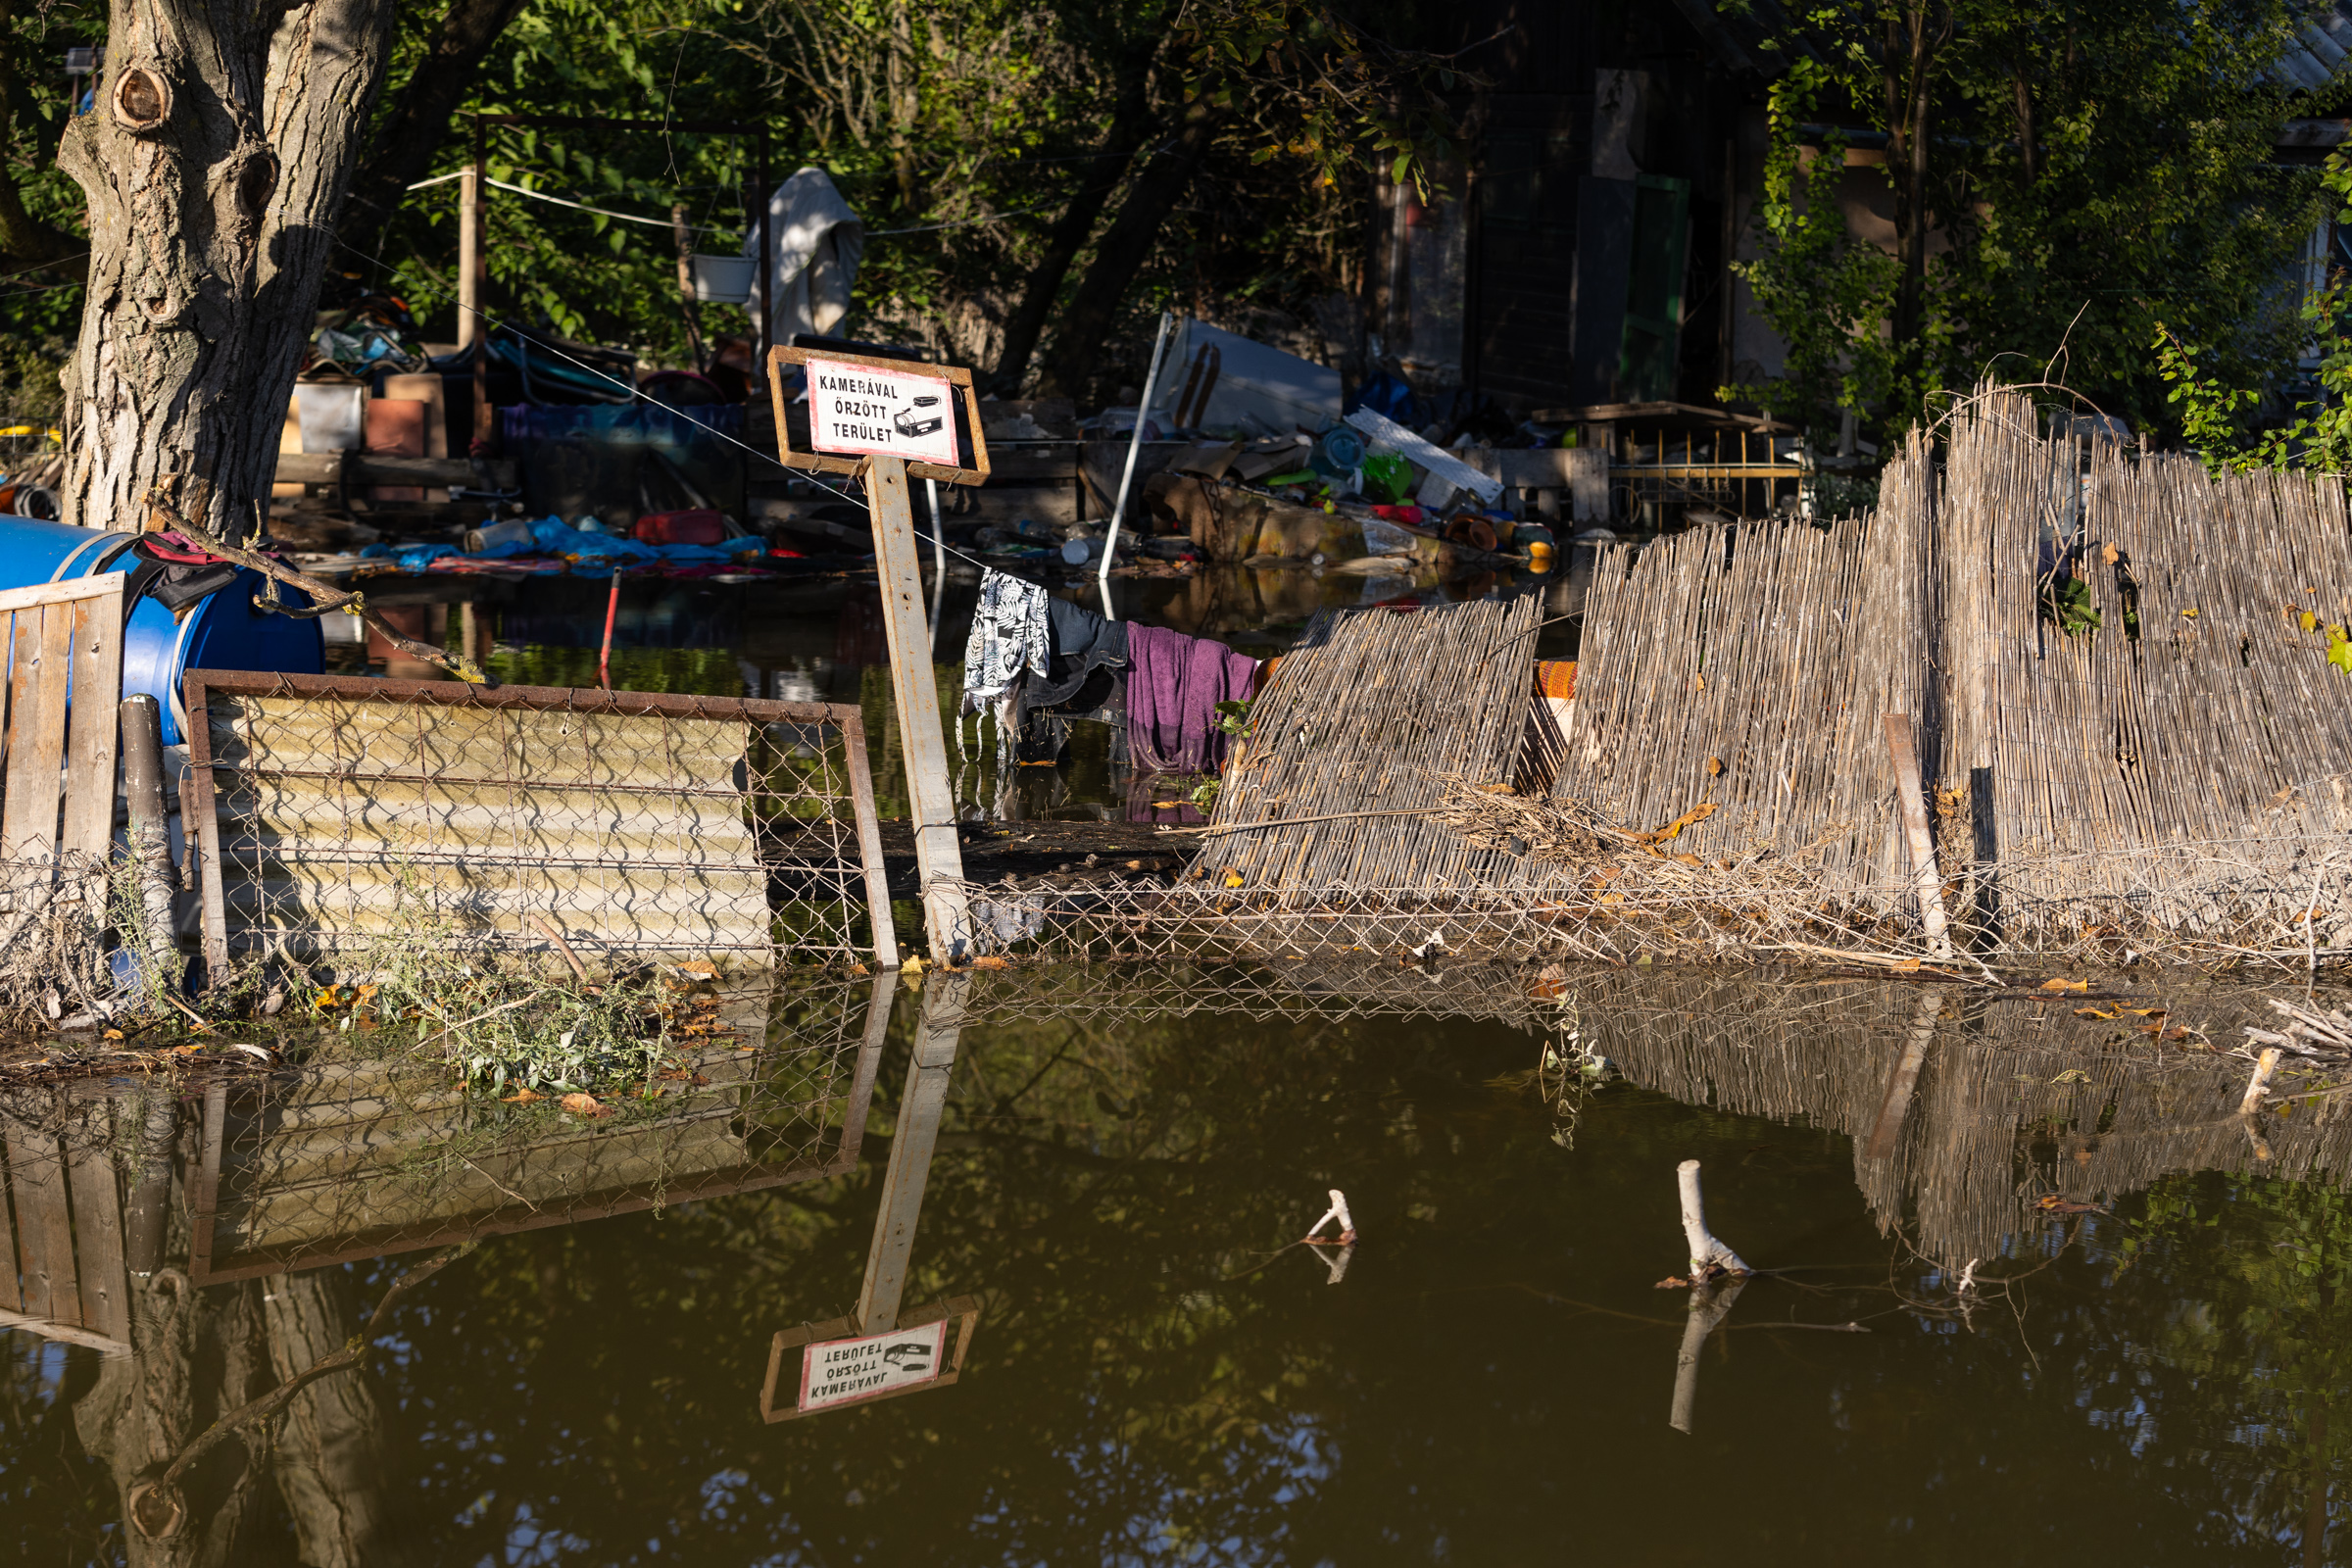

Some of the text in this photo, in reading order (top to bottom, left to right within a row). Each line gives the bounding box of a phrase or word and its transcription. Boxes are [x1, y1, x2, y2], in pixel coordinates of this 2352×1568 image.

[819, 375, 899, 399] KAMERÁVAL
[835, 397, 886, 419] ŐRZÖTT
[833, 421, 893, 442] TERÜLET
